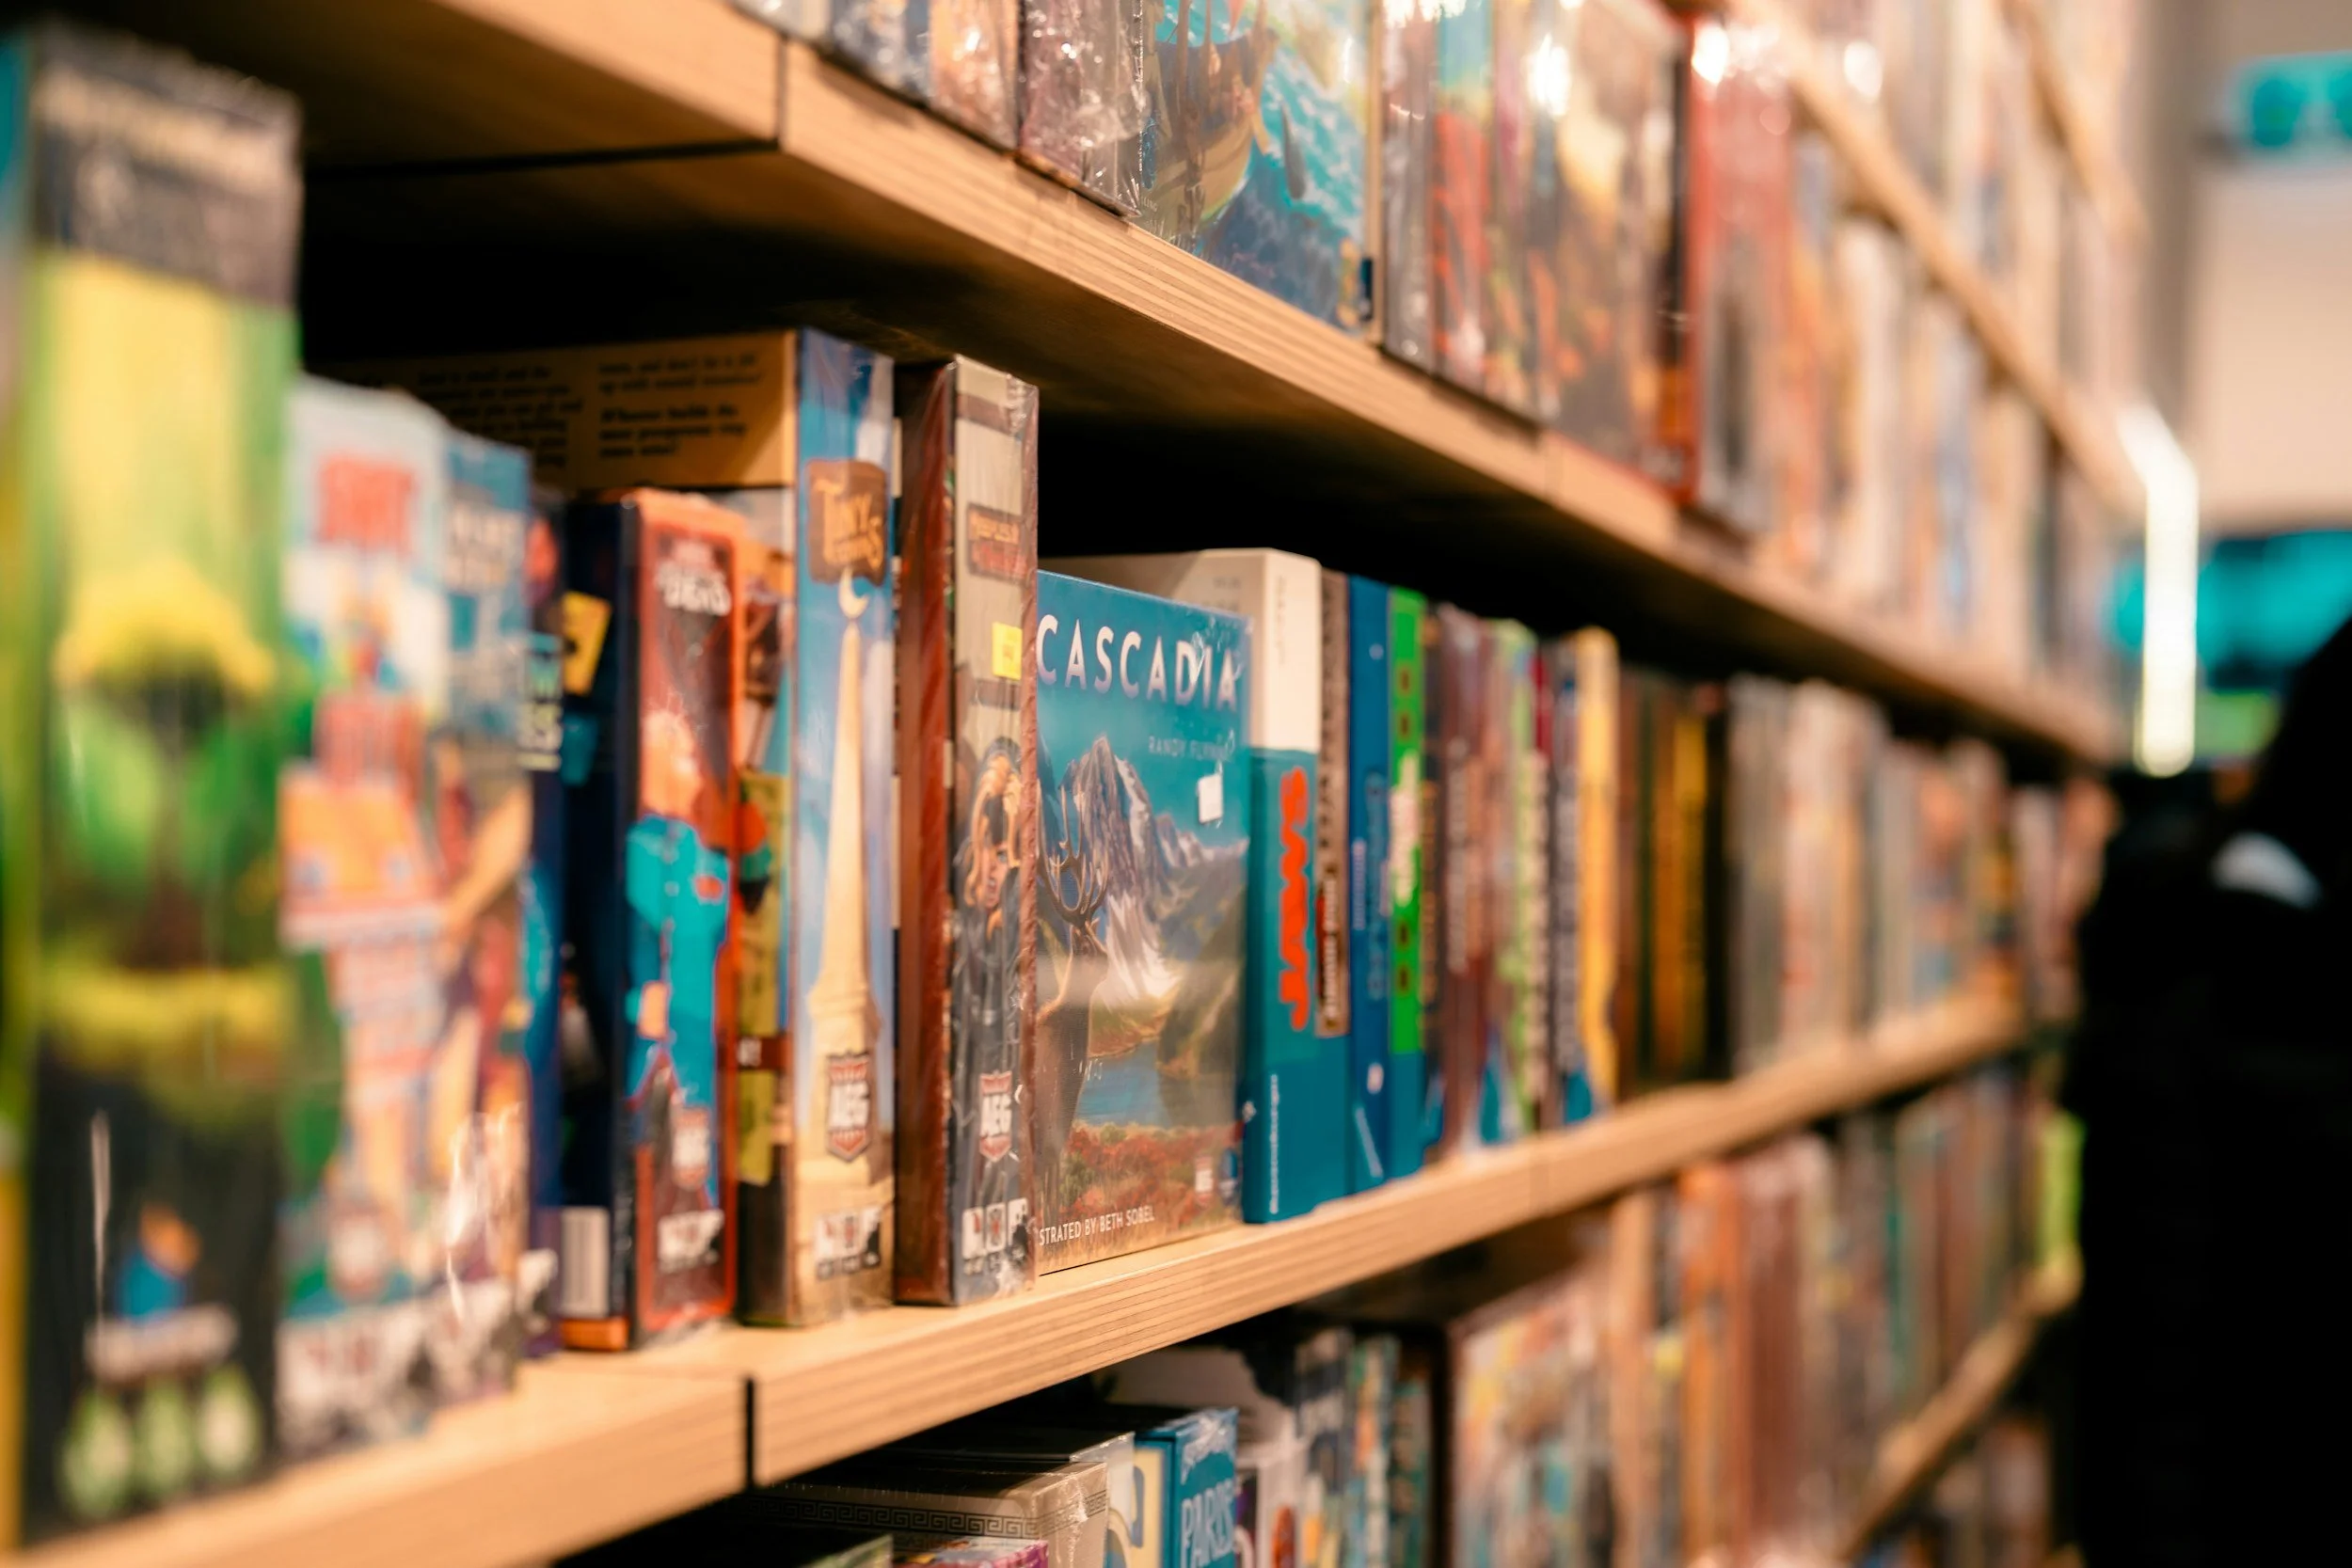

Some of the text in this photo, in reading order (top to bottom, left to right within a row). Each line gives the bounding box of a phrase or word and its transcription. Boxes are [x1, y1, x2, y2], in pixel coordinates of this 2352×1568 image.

[1036, 613, 1237, 711] CASCADIA
[1279, 766, 1311, 1031] JAWS
[1084, 1217, 1097, 1236] BY
[1099, 1212, 1124, 1233] BETH
[1125, 1205, 1155, 1227] SOBEL
